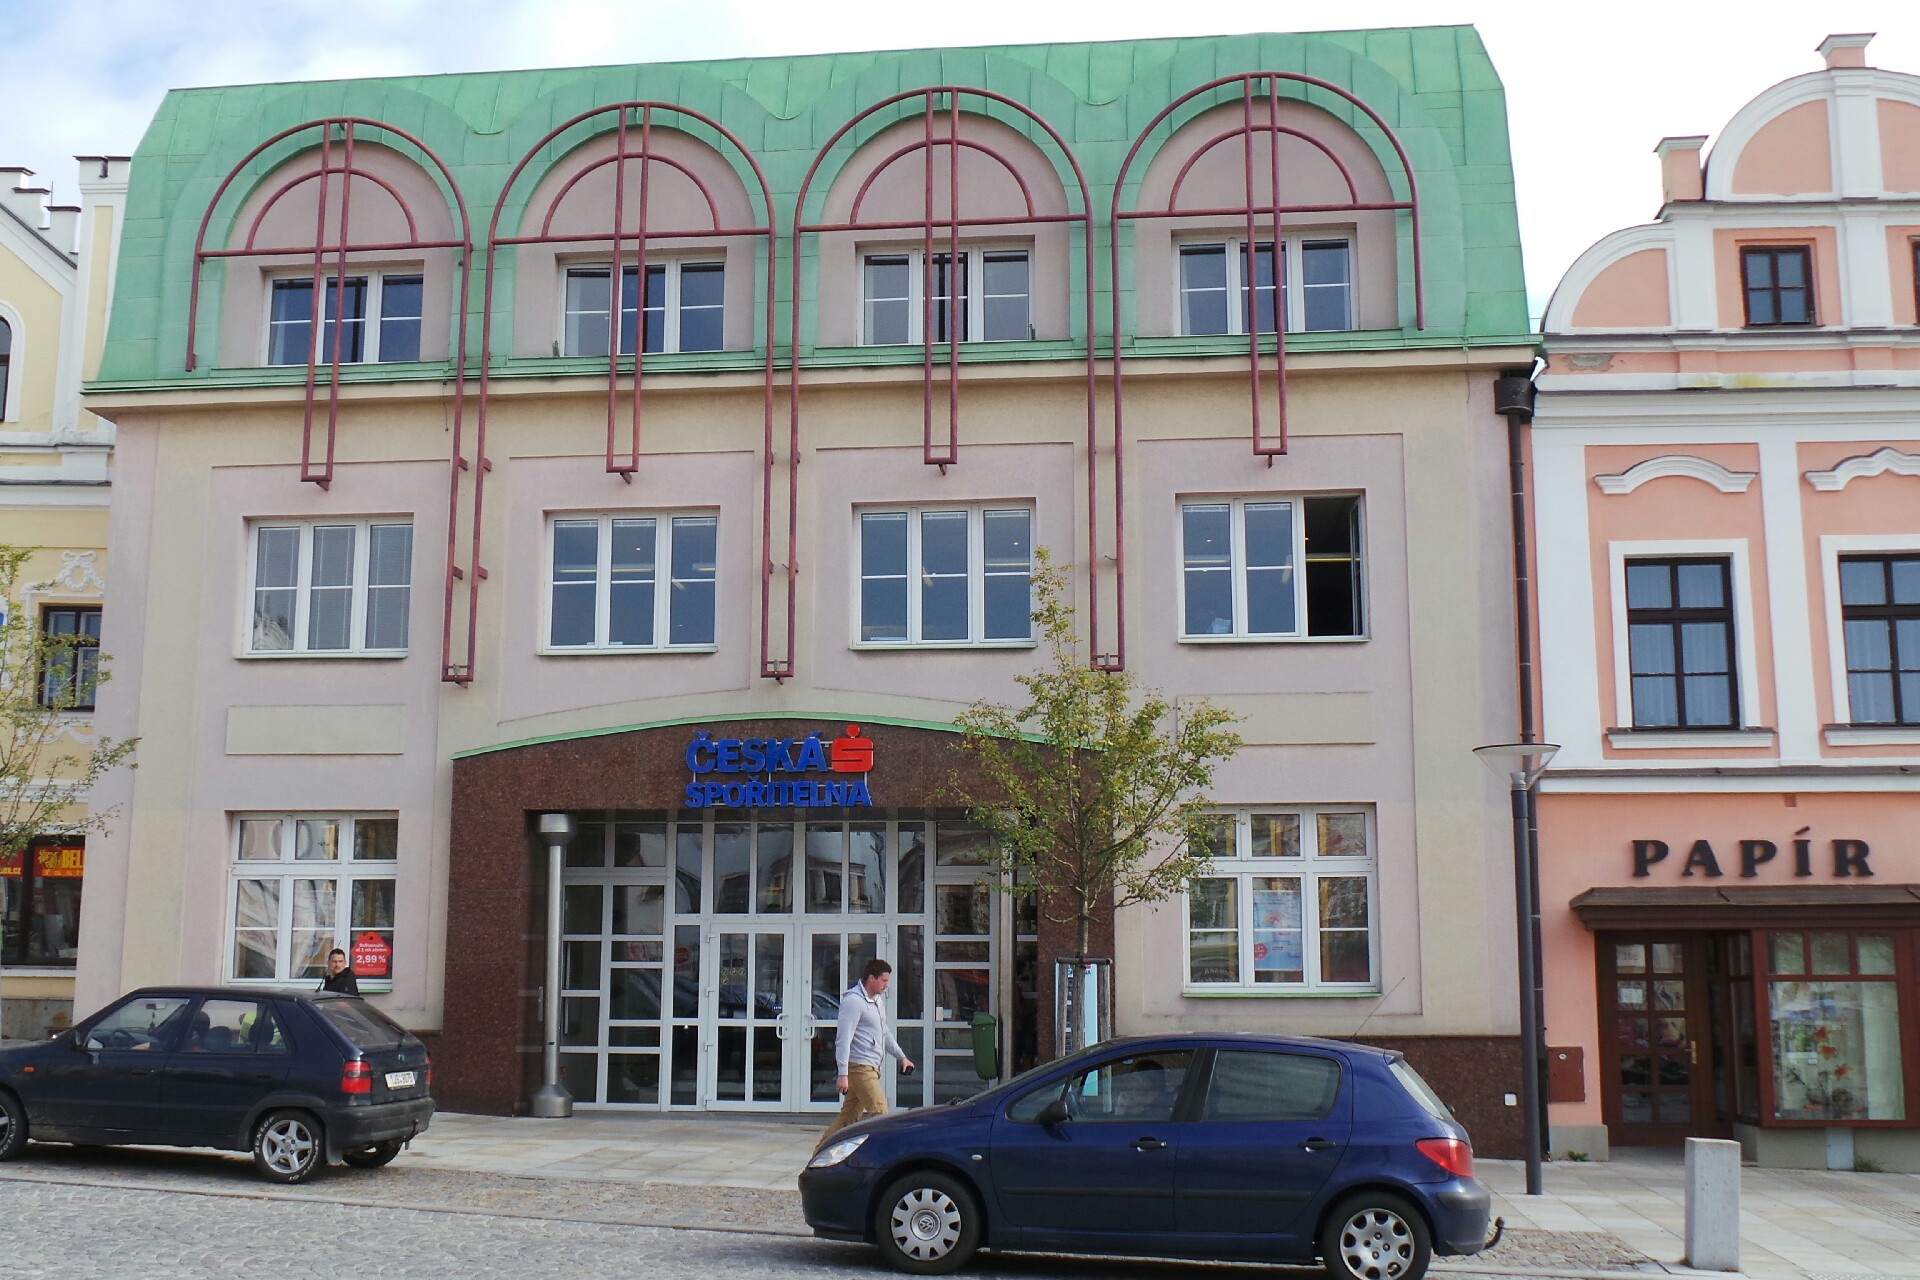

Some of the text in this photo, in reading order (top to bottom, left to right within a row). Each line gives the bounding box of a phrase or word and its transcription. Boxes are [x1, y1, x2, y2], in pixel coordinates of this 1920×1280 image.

[685, 730, 828, 773] ČESKÁ
[685, 775, 872, 807] SPOŘITELNA
[1631, 826, 1874, 878] PAPÍR
[355, 954, 386, 965] 2,99 %
